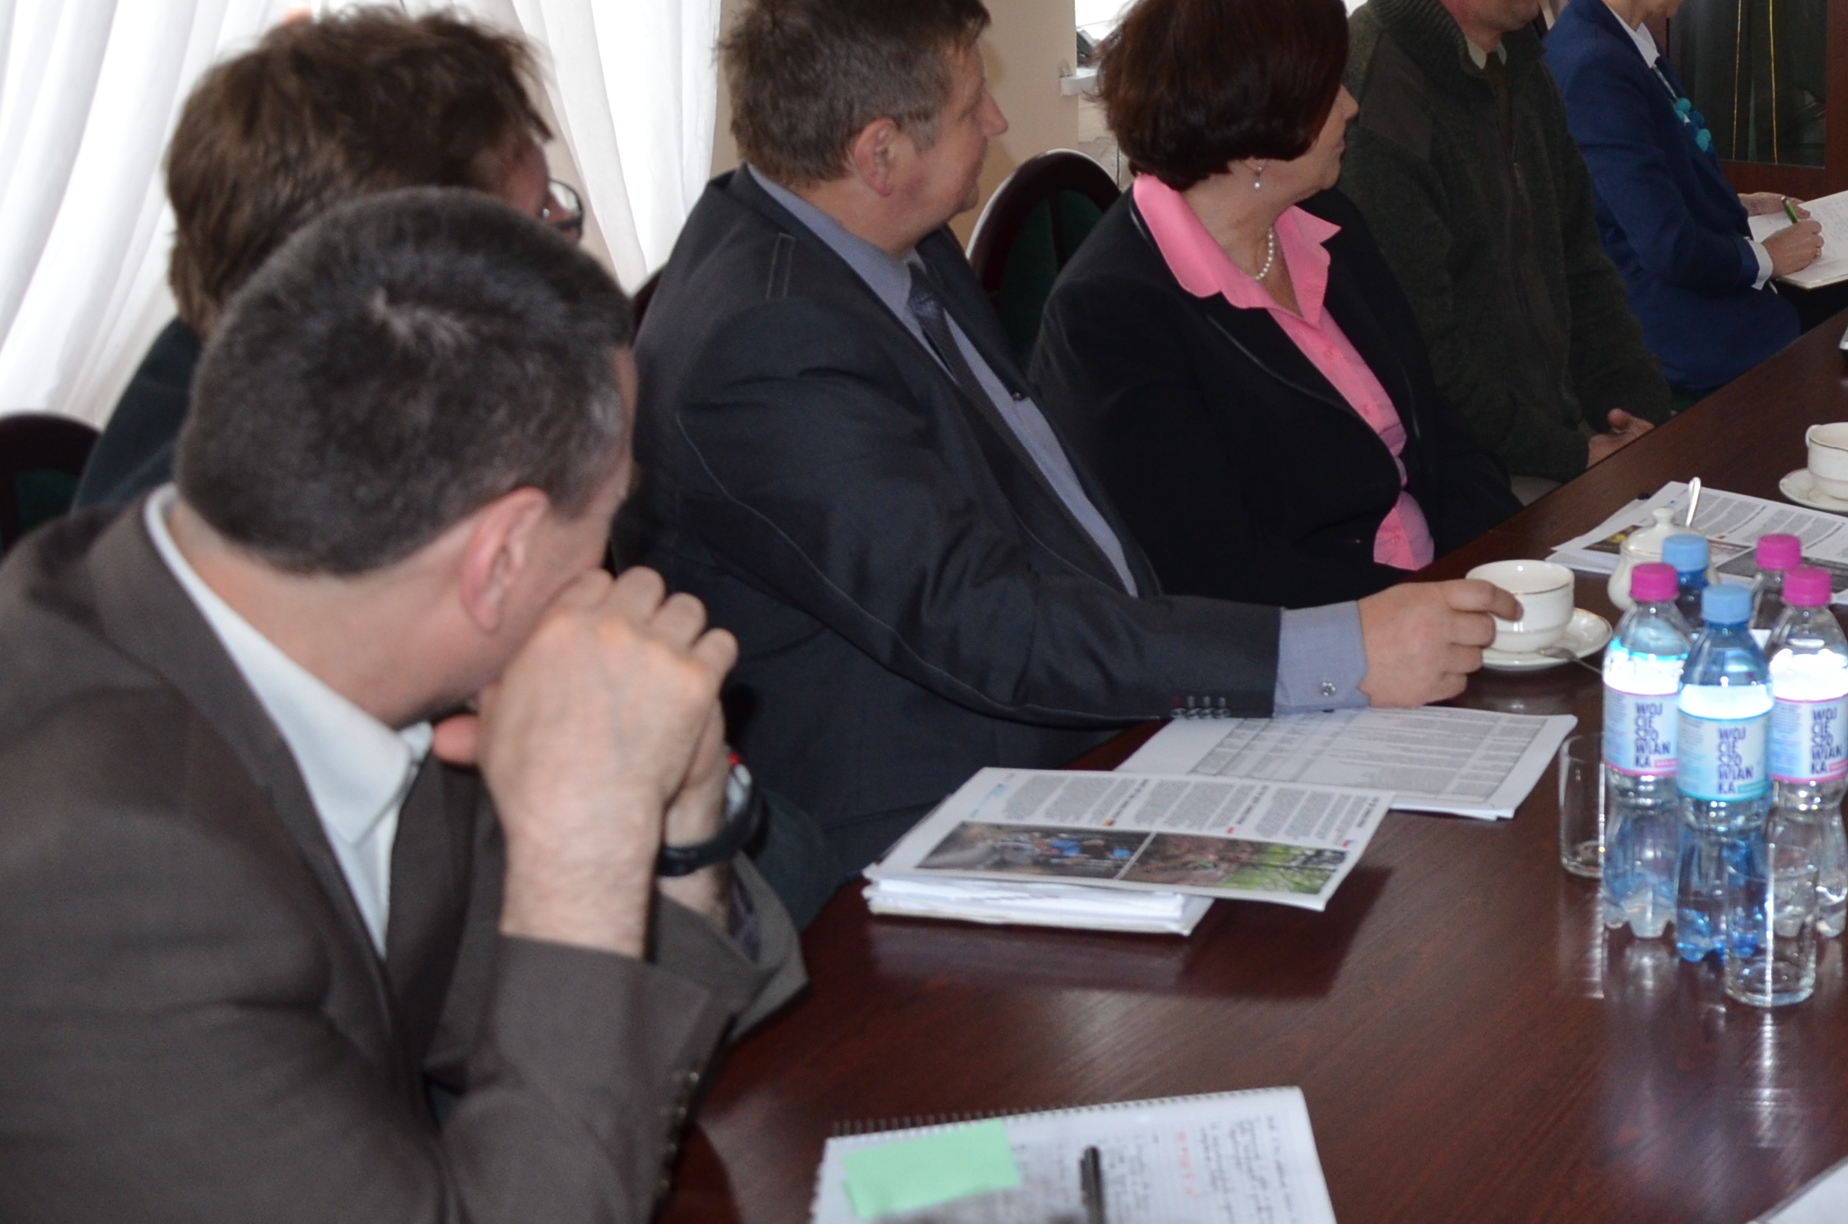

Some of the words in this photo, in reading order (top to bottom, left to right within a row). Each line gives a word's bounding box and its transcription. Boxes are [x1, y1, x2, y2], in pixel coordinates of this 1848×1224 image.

[1635, 702, 1663, 716] WOJ
[1812, 707, 1837, 721] WOJ
[1718, 727, 1746, 740] WOJ
